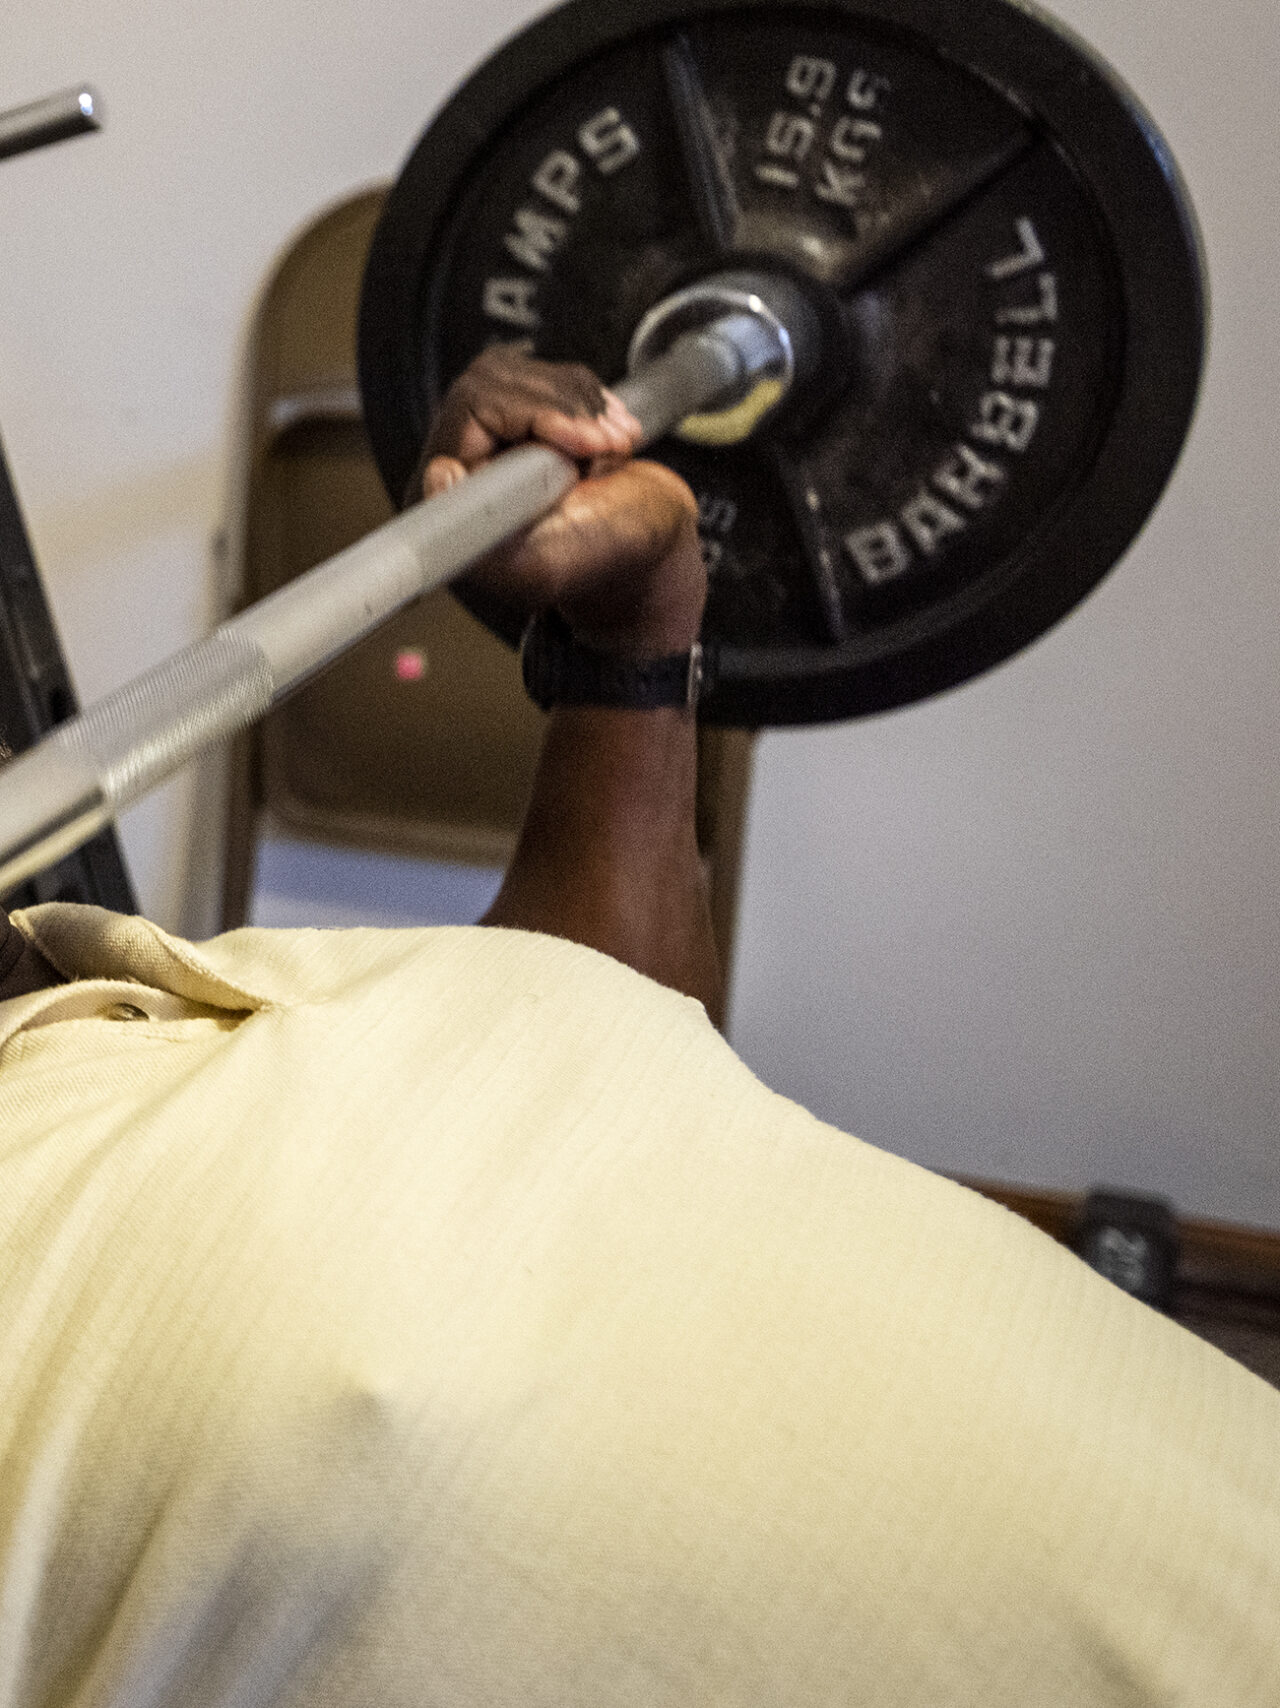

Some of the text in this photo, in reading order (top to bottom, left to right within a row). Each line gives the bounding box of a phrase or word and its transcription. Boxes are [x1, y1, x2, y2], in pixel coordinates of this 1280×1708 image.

[481, 106, 641, 353] AMPS
[756, 55, 837, 188] 15.9
[844, 216, 1058, 583] BARBELL
